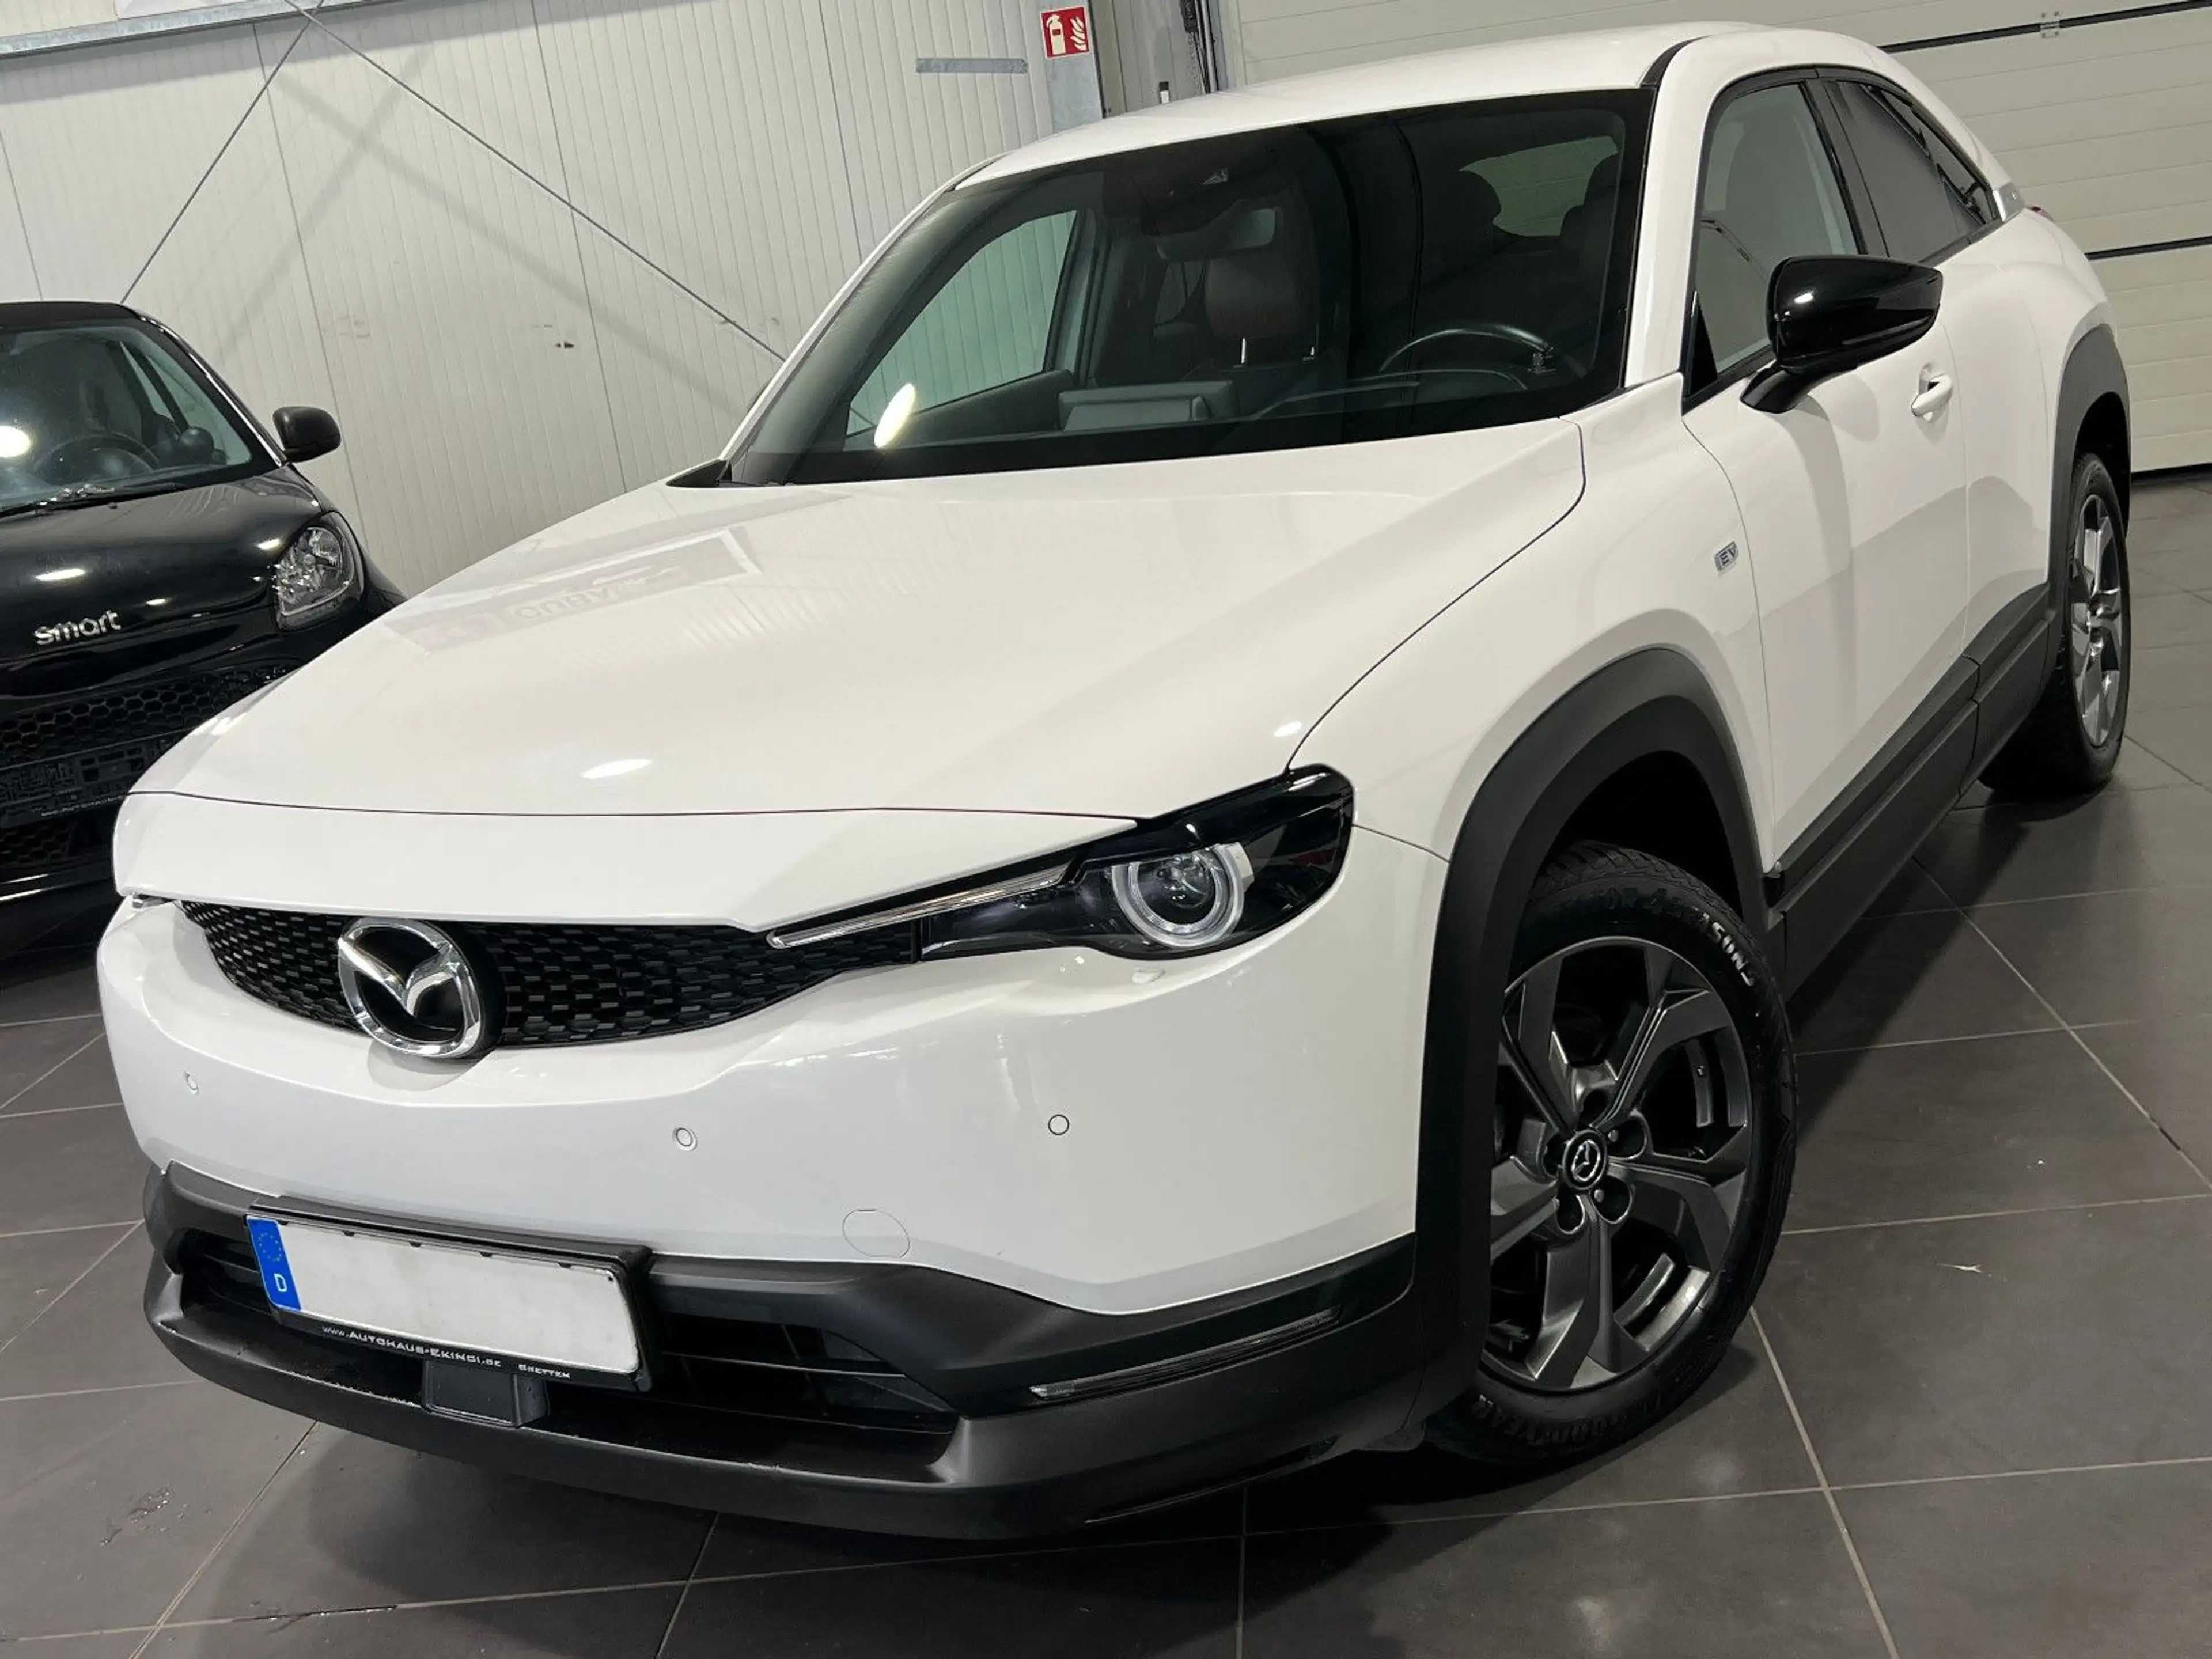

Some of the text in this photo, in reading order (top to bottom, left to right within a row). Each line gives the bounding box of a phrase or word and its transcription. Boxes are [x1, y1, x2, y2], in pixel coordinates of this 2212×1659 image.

[1719, 547, 1736, 566] EV
[34, 609, 121, 645] smart
[274, 1272, 287, 1292] D
